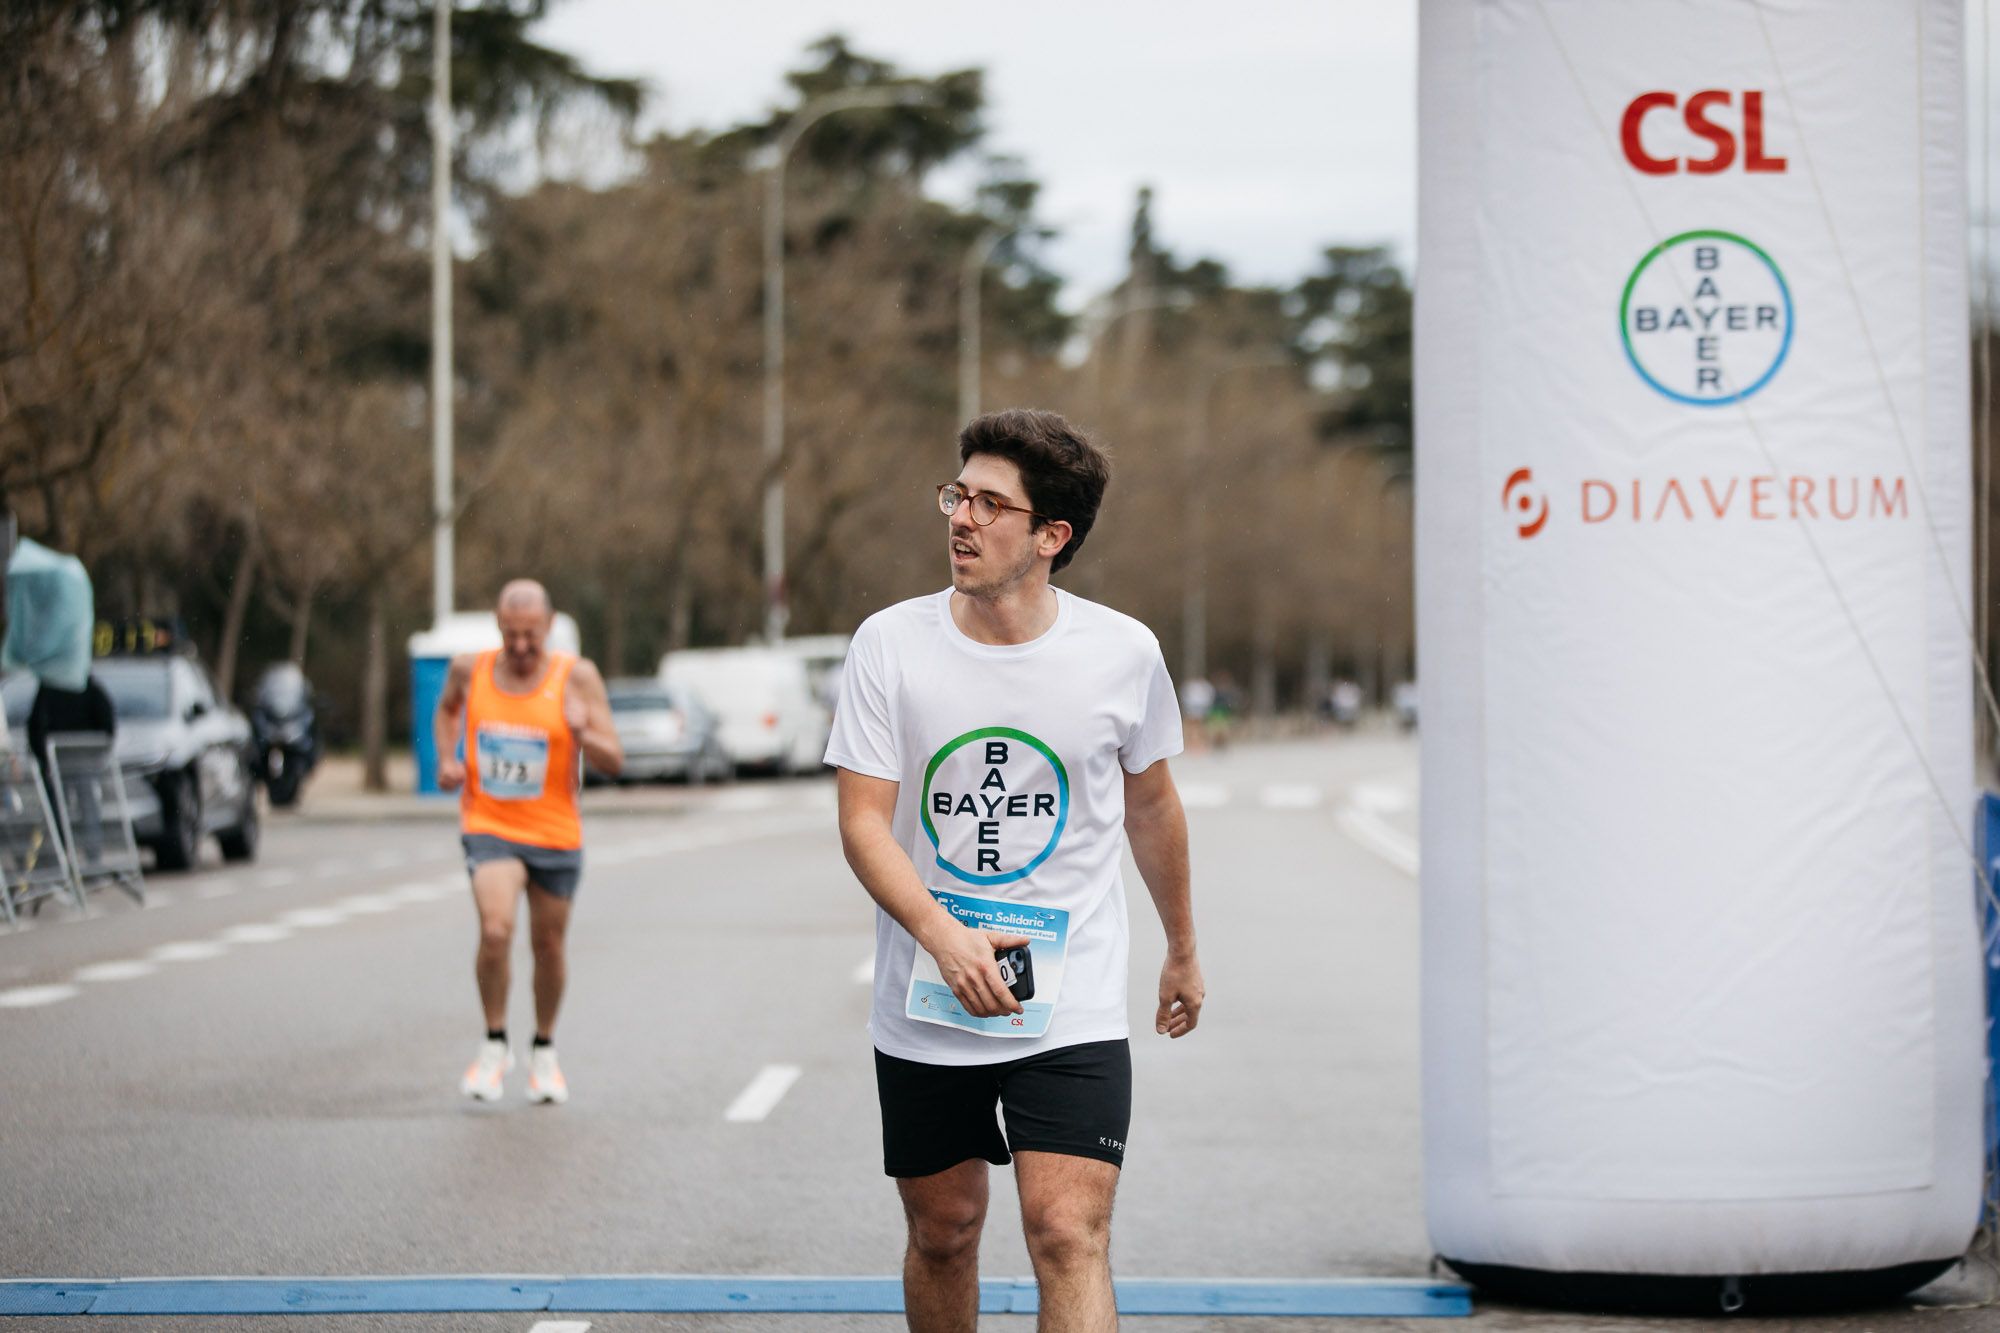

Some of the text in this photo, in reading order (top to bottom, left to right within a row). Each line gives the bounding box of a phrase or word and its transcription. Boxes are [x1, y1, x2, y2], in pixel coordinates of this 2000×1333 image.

[1619, 90, 1788, 177] CSL
[1635, 305, 1779, 333] BAYER
[1694, 246, 1722, 391] BAYER
[1580, 476, 1909, 524] DIAVERUM
[933, 792, 1055, 818] BAYER
[977, 742, 1009, 872] BAYER
[951, 904, 992, 920] Carrera
[995, 912, 1044, 927] Solidaria
[1011, 1018, 1024, 1026] CSL
